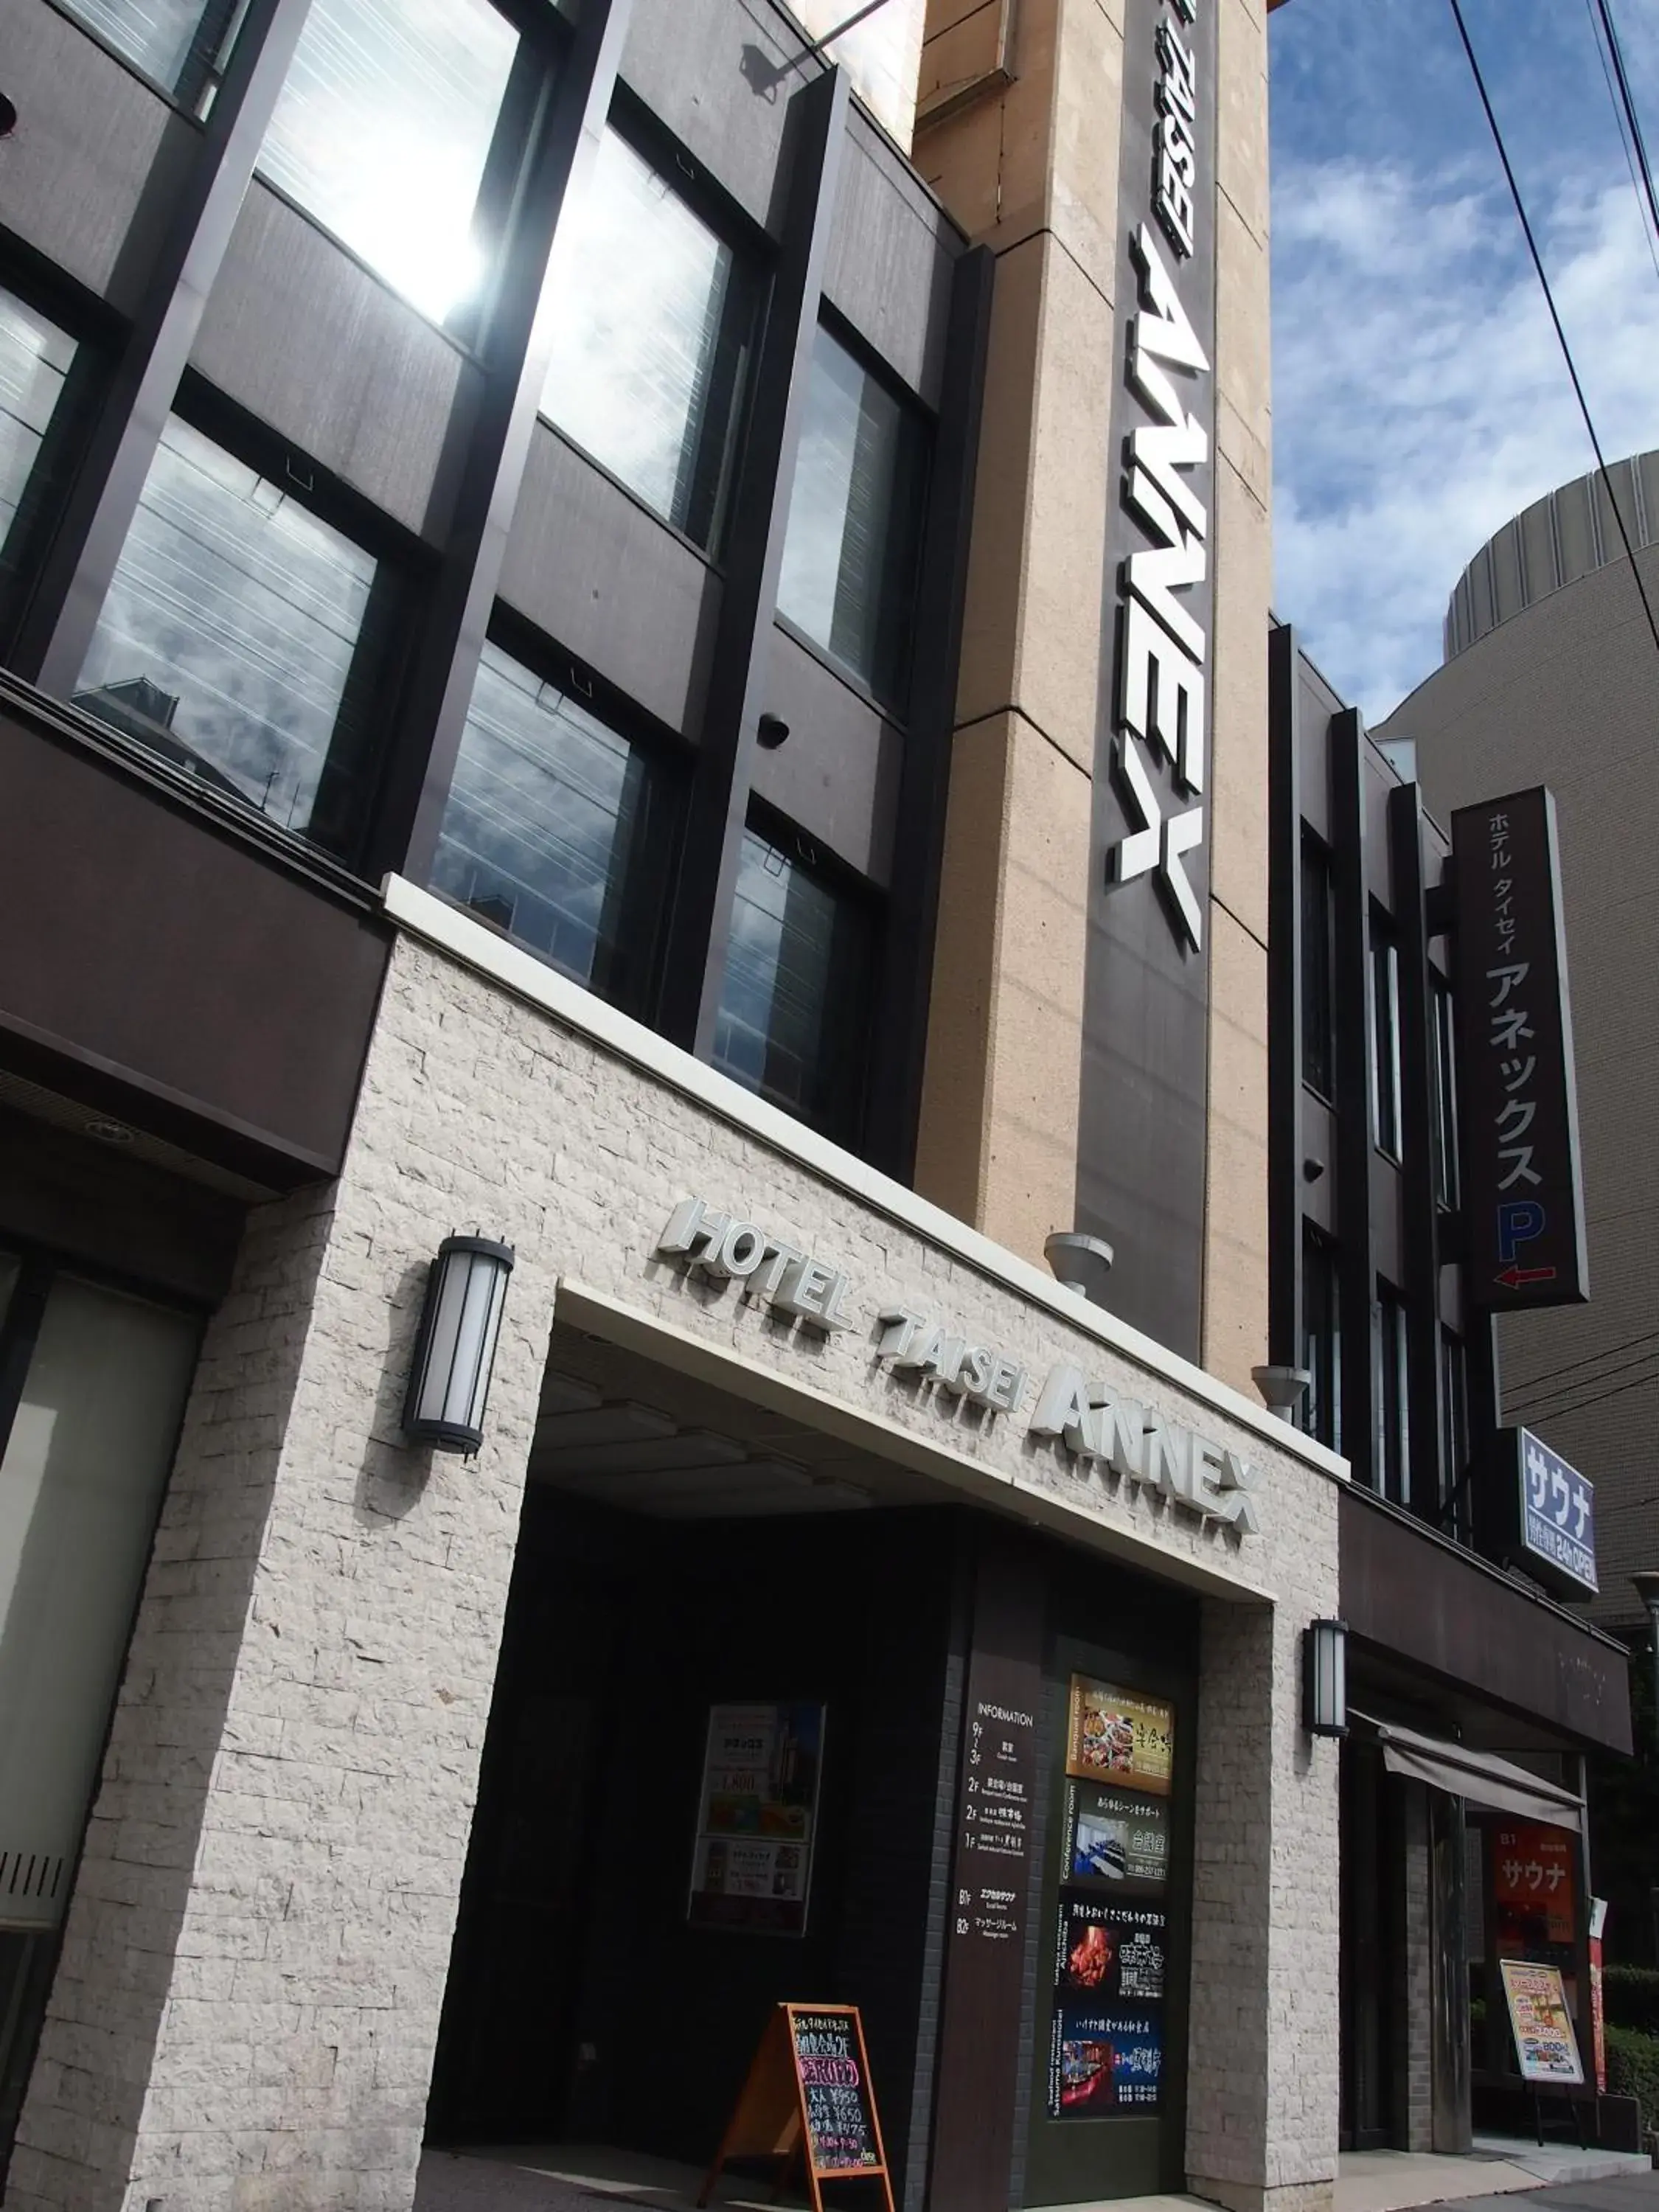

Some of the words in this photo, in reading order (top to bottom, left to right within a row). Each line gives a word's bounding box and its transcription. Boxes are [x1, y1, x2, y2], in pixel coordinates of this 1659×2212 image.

[1158, 18, 1196, 259] TAISEI
[1112, 221, 1210, 953] ANNEX
[1489, 813, 1511, 871] ホテル
[1494, 877, 1516, 956] タイセイ
[1486, 961, 1543, 1192] アネックス
[1497, 1200, 1546, 1262] P
[658, 1196, 855, 1332] HOTEL
[877, 1304, 1031, 1414] TAISEI
[1032, 1364, 1259, 1536] ANNEX
[1528, 1445, 1590, 1539] サウナ
[978, 1703, 1033, 1728] INFORMATION
[968, 1776, 979, 1792] 2F
[970, 1750, 982, 1766] 3F
[965, 1832, 976, 1848] 1F
[966, 1805, 977, 1820] 2F
[1062, 1816, 1074, 1879] Conference
[1502, 1859, 1565, 1892] サウナ
